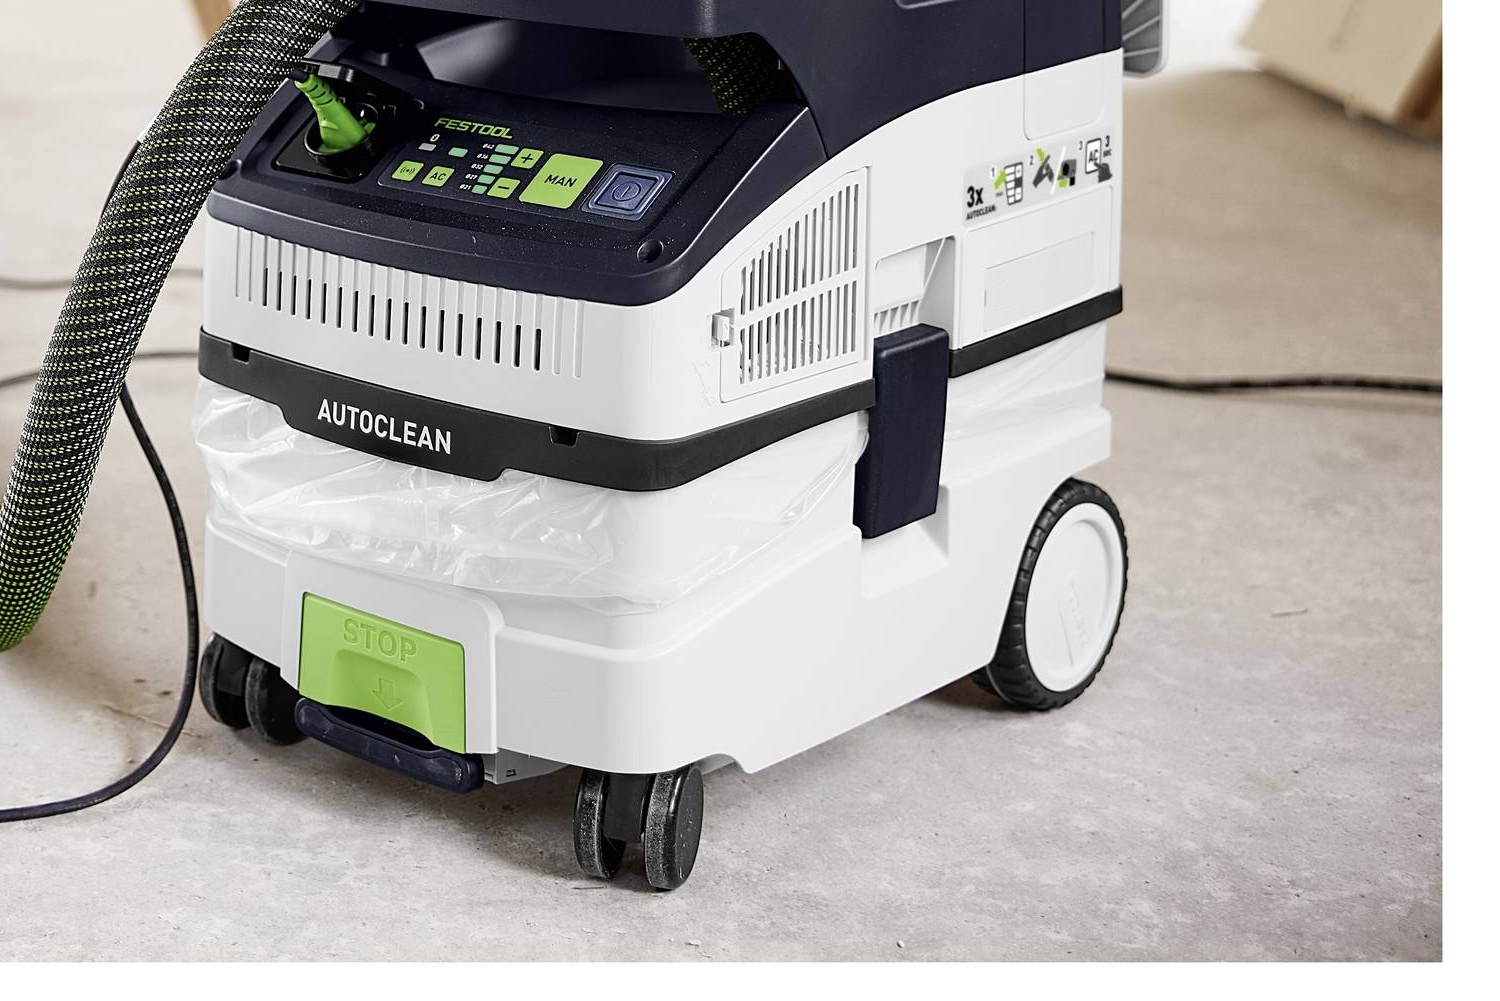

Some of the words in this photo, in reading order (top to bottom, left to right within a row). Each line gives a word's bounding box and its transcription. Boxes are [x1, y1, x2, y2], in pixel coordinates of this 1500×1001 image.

[434, 117, 513, 139] FESTOOL
[1105, 135, 1110, 147] 3
[1088, 148, 1099, 164] AC
[429, 172, 447, 181] AC
[543, 174, 578, 188] MAN
[966, 185, 984, 208] 3x
[317, 398, 451, 455] AUTOCLEAN
[343, 618, 417, 662] STOP
